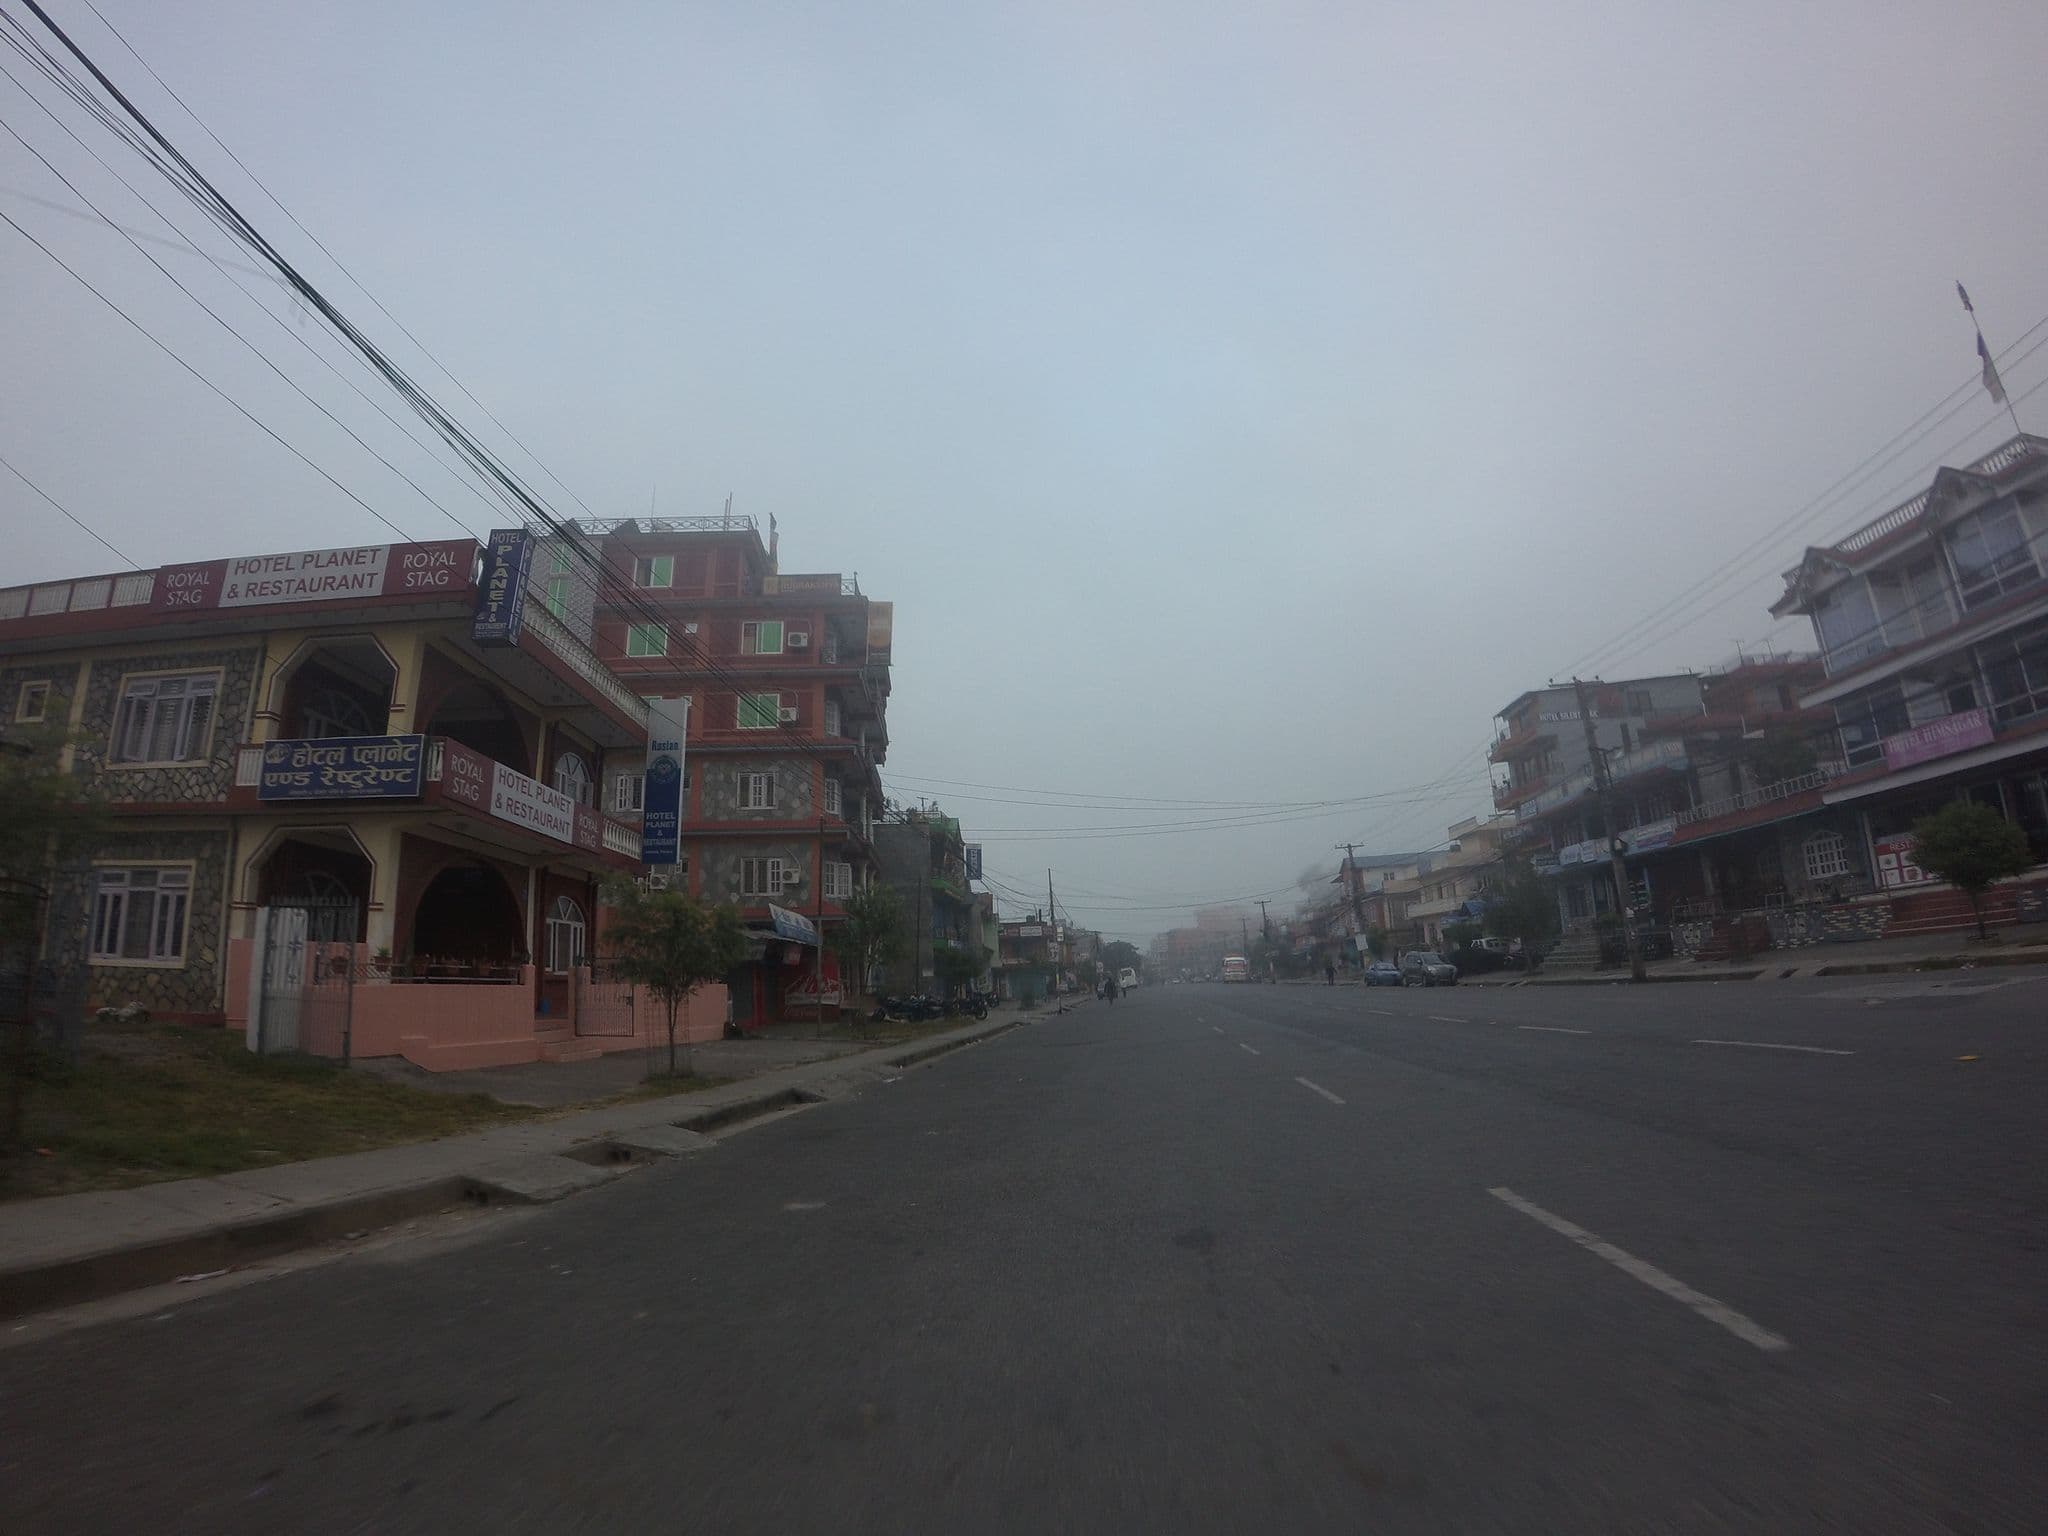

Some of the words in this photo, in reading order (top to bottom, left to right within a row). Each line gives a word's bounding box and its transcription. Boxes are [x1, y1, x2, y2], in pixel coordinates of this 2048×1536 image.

[489, 532, 521, 543] HOTEL
[234, 554, 300, 575] HOTEL
[302, 548, 382, 569] PLANET
[402, 550, 457, 568] ROYAL
[166, 571, 210, 588] ROYAL
[227, 583, 239, 599] &
[245, 572, 378, 598] RESTAURANT
[405, 569, 449, 587] STAG
[488, 545, 513, 612] PLANET
[166, 589, 202, 606] STAG
[292, 742, 348, 768] होटल
[353, 739, 419, 765] प्लानेट
[451, 754, 484, 783] ROYAL
[264, 771, 314, 788] एण्ड
[452, 777, 480, 801] STAG
[499, 770, 533, 798] HOTEL
[536, 786, 572, 814] PLANET
[495, 792, 502, 809] &
[507, 799, 571, 836] RESTAURANT
[579, 813, 599, 833] ROYAL
[646, 812, 676, 820] HOTEL
[580, 831, 597, 848] STAG
